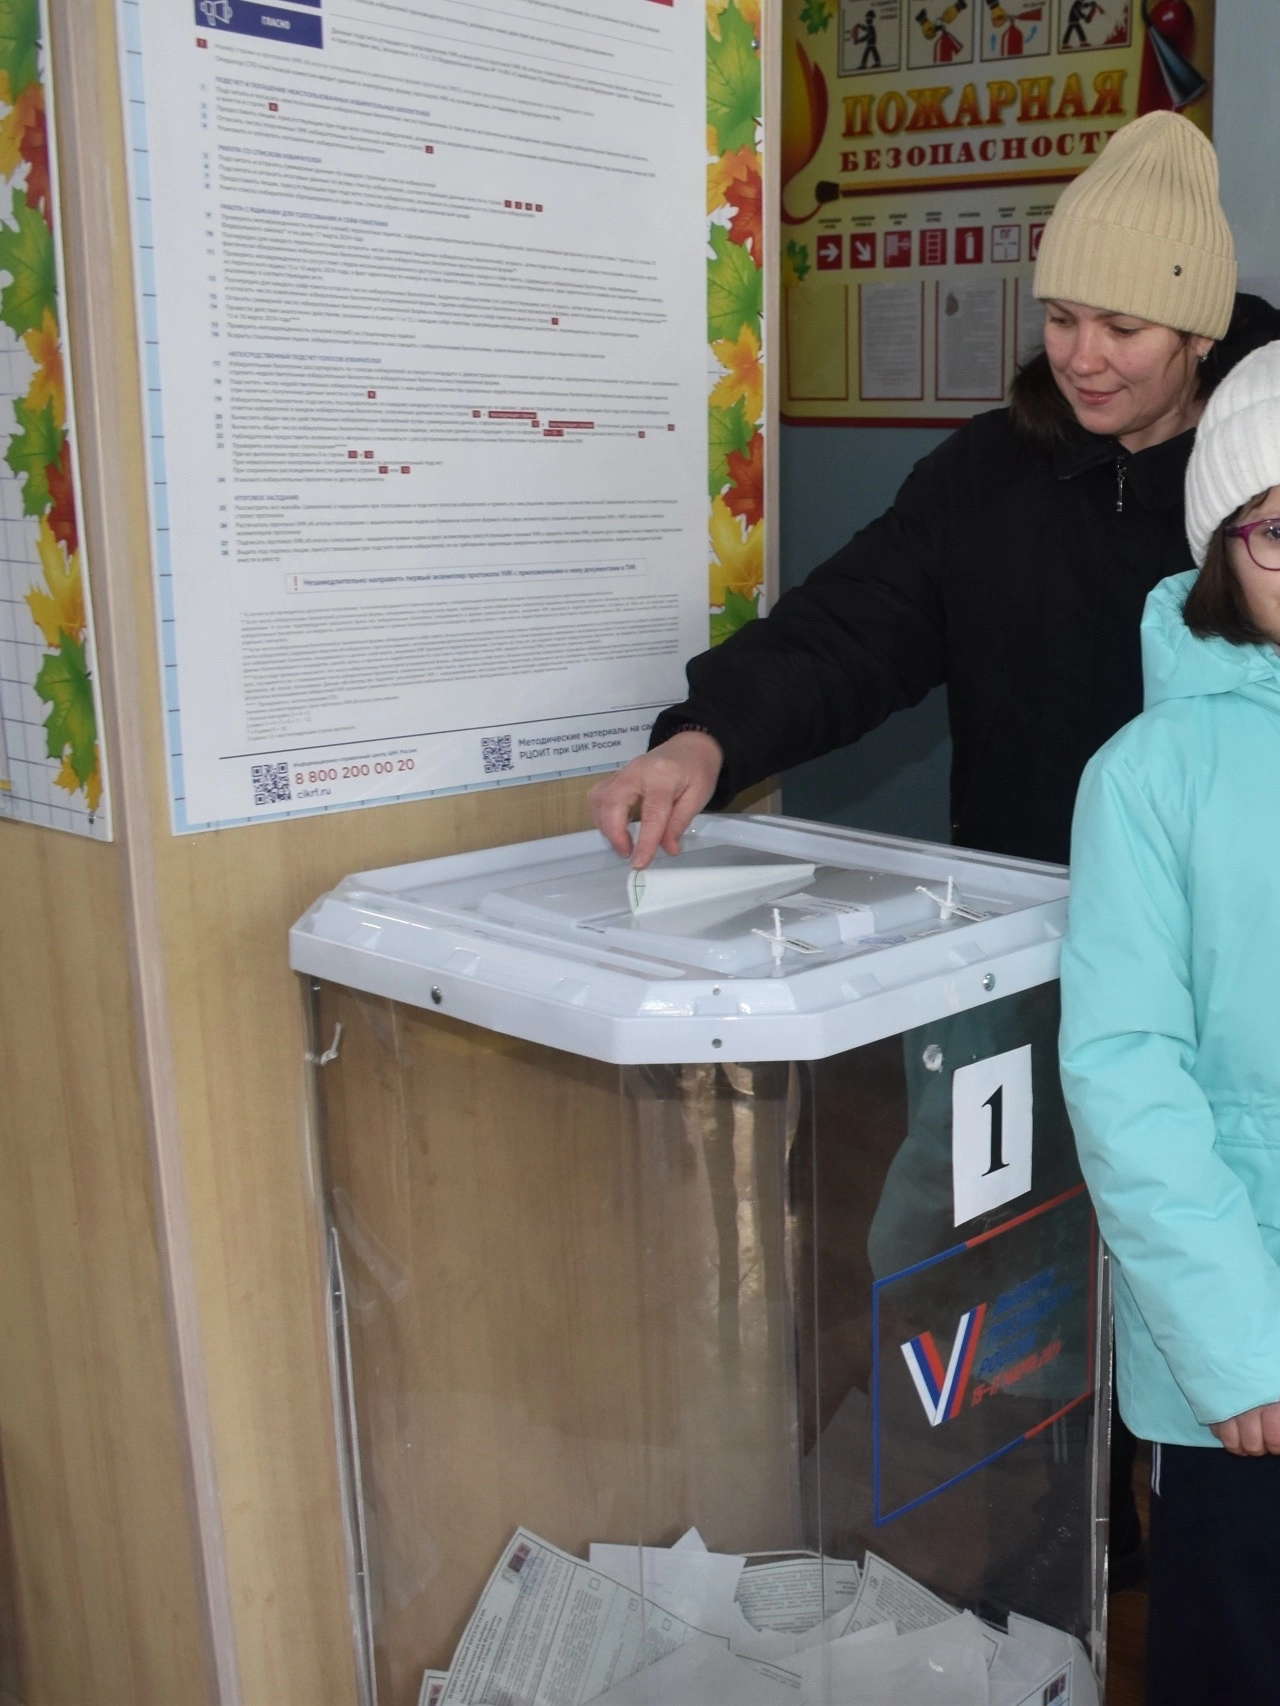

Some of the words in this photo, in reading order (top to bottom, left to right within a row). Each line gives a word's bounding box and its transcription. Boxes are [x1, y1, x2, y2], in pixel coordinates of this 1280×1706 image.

[841, 69, 1128, 138] ПОЖАРНАЯ
[519, 732, 580, 746] Методические
[582, 727, 628, 740] материалы
[519, 748, 550, 760] РЦОИТ
[553, 746, 570, 755] при
[572, 743, 590, 753] ЦИК
[592, 739, 621, 749] России
[295, 773, 304, 784] 8
[309, 768, 338, 783] 800
[342, 764, 370, 779] 200
[374, 761, 393, 774] 00
[398, 759, 415, 771] 20
[297, 787, 331, 799] cikrf.ru
[980, 1084, 1010, 1178] 1
